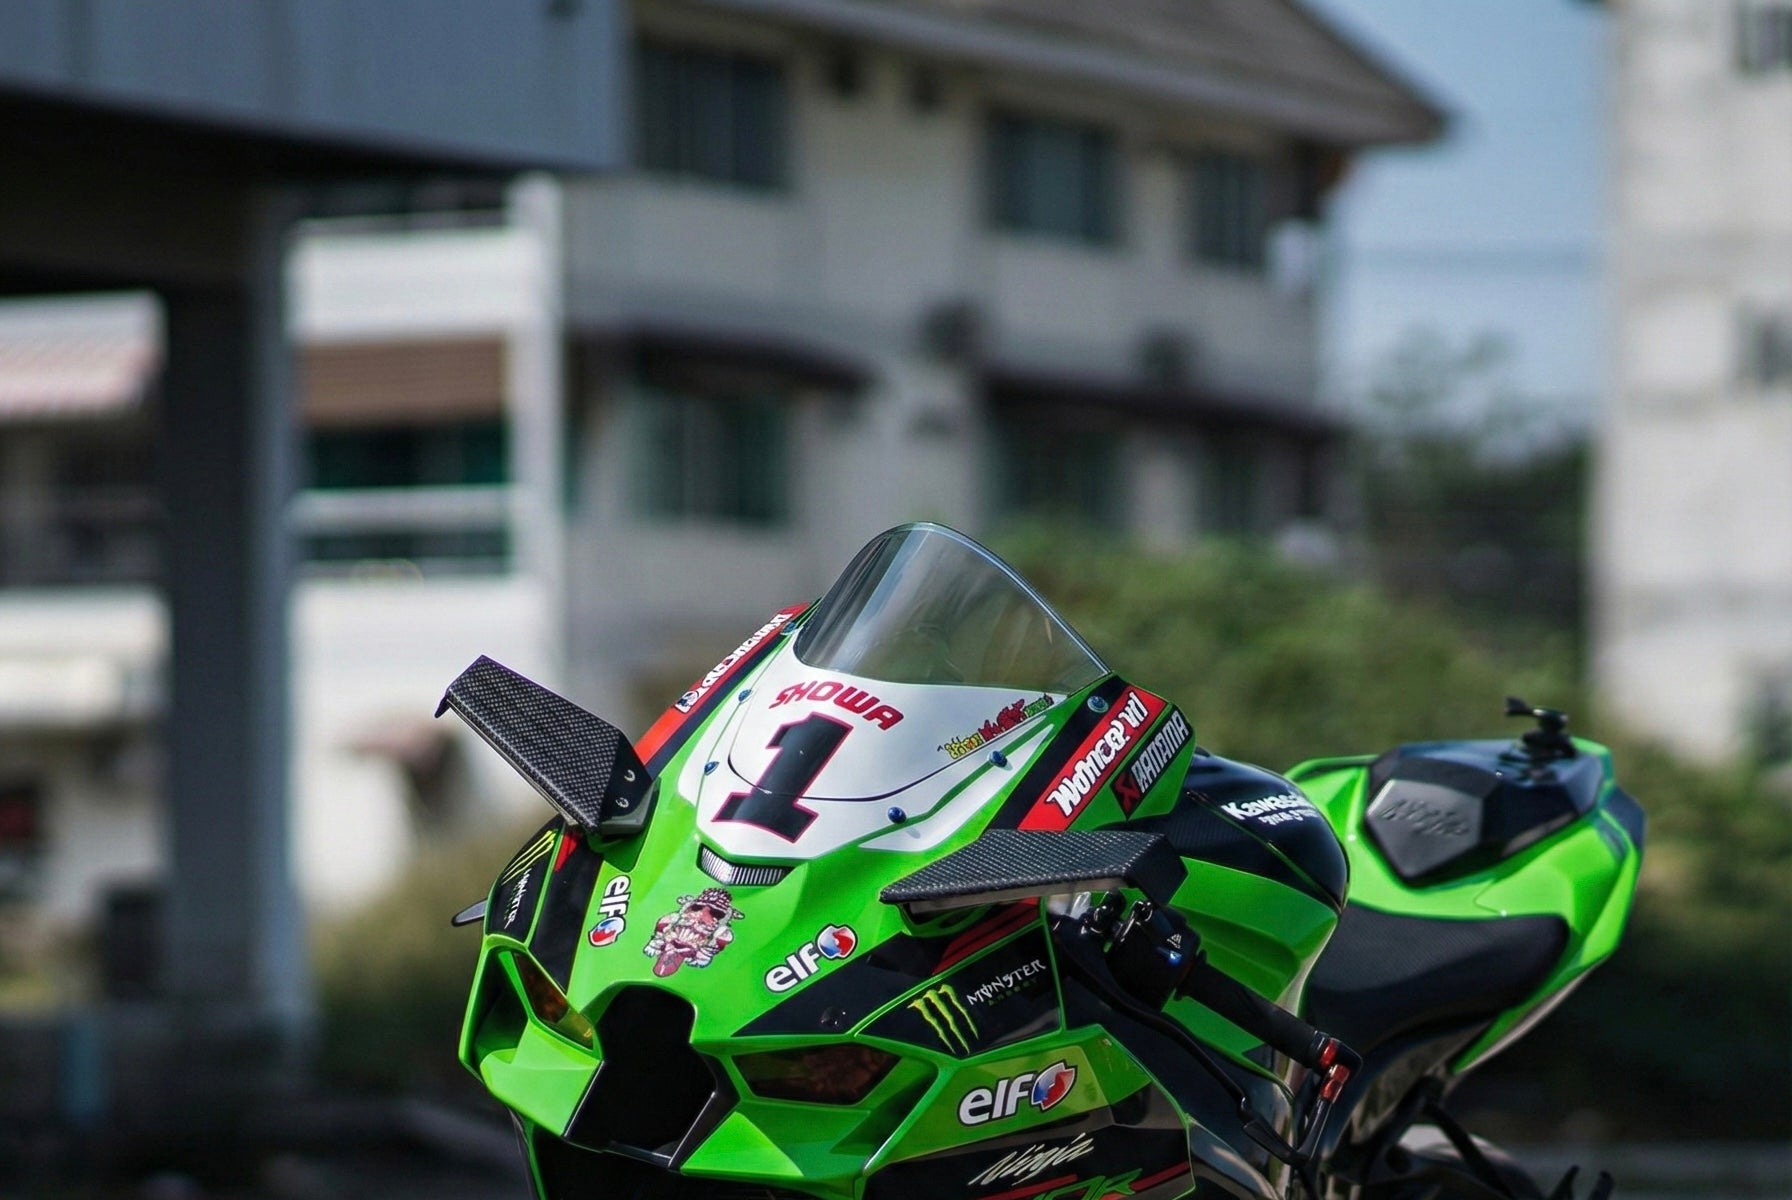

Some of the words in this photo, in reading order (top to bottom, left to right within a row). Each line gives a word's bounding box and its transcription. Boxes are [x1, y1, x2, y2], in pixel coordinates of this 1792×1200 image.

[768, 680, 905, 731] SHOWA
[711, 711, 854, 843] 1
[600, 875, 630, 917] elf
[765, 942, 820, 992] elf
[966, 959, 1047, 1005] MONSTER
[959, 1073, 1034, 1125] elf
[967, 1132, 1095, 1186] Ninja
